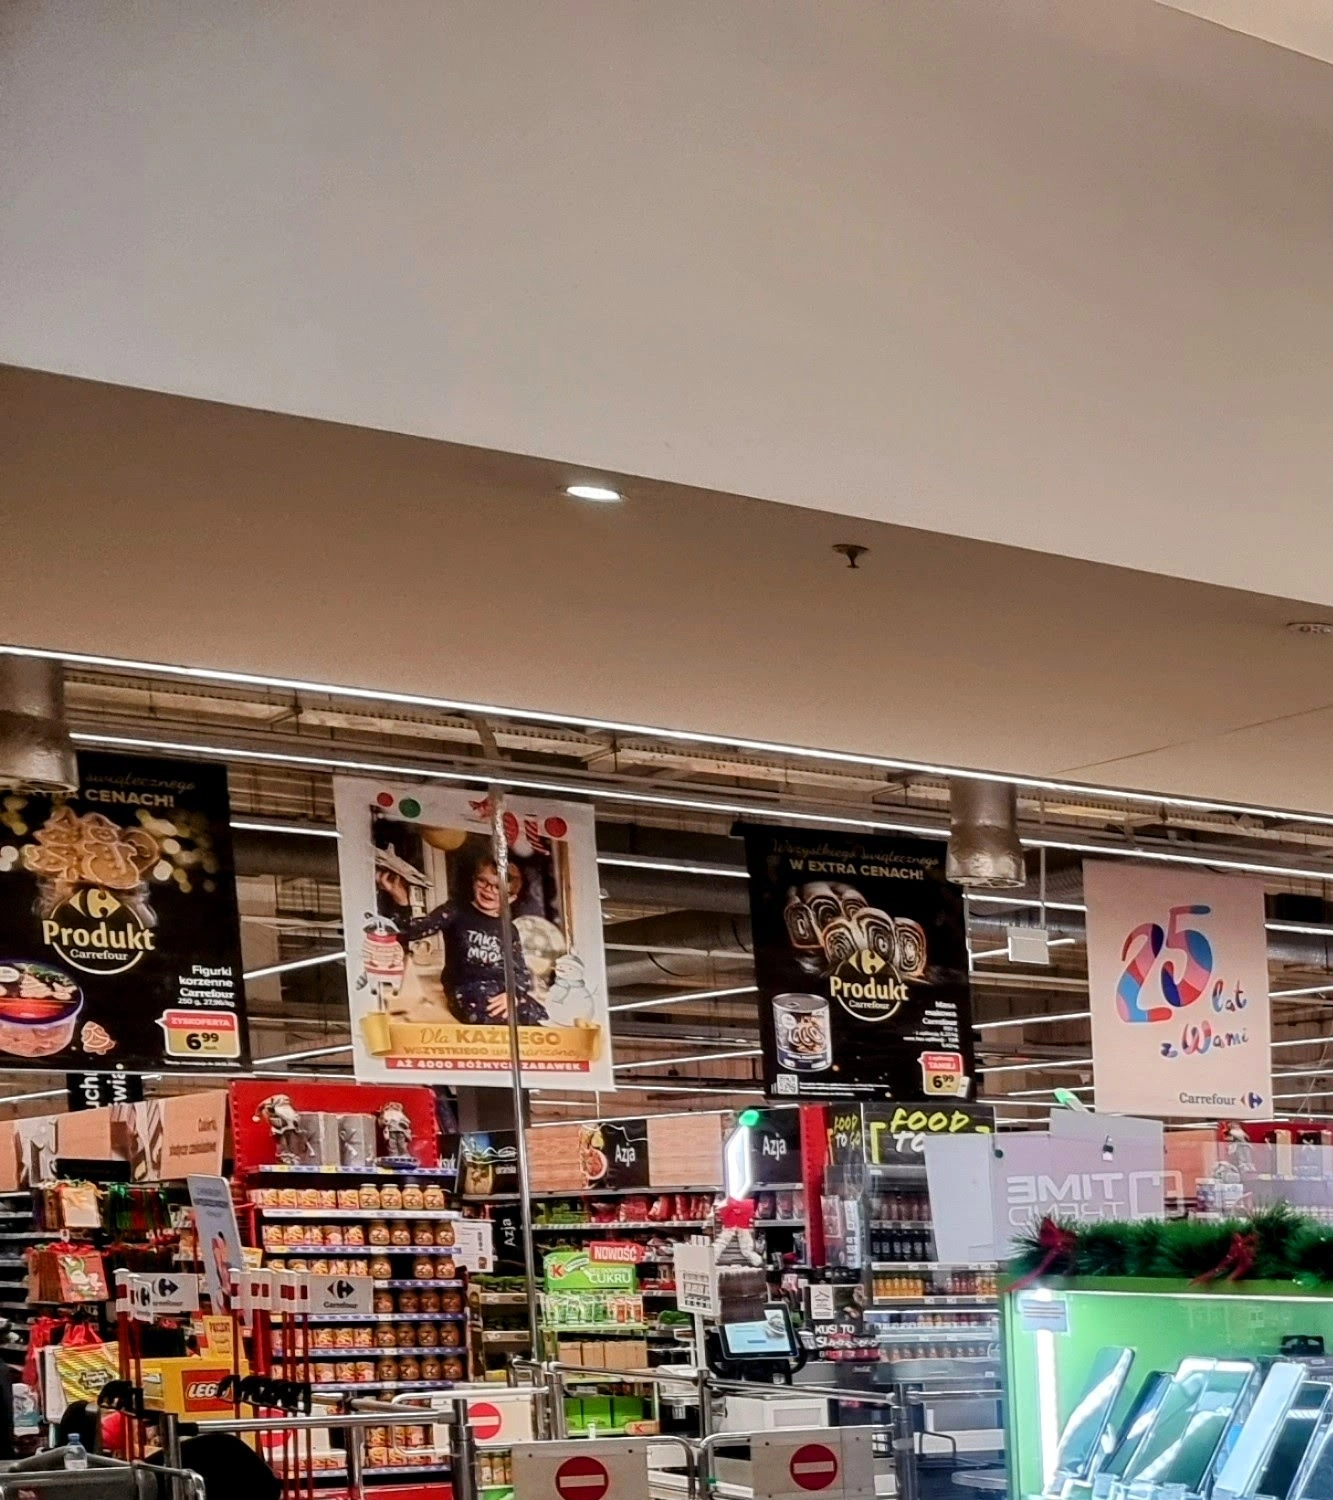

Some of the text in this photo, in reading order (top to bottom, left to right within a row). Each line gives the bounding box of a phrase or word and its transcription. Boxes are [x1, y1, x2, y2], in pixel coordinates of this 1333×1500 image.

[85, 789, 175, 808] CENACH!
[789, 859, 924, 881] W EXTRA CENACH!
[43, 920, 156, 951] Produkt
[70, 948, 128, 961] Carrefour
[192, 965, 232, 977] Figurki
[1116, 905, 1213, 1023] 25
[179, 976, 233, 988] korzenne
[830, 976, 910, 1001] Produkt
[180, 987, 236, 999] Carrefour
[1212, 979, 1247, 1013] lat
[420, 1027, 450, 1044] Dla
[1160, 1020, 1249, 1058] z Wami
[418, 1059, 453, 1069] 4000
[522, 1061, 581, 1071] ZABAWEK
[1179, 1092, 1236, 1105] Carrefour
[834, 1114, 858, 1132] FOOD
[891, 1107, 969, 1132] FOOD
[763, 1133, 787, 1161] Azja
[836, 1133, 847, 1148] TO
[615, 1143, 636, 1167] Azja
[502, 1218, 517, 1247] Azja
[594, 1244, 638, 1262] NOWOŚĆ
[588, 1271, 632, 1284] CUKRU
[187, 1382, 229, 1399] LEG
